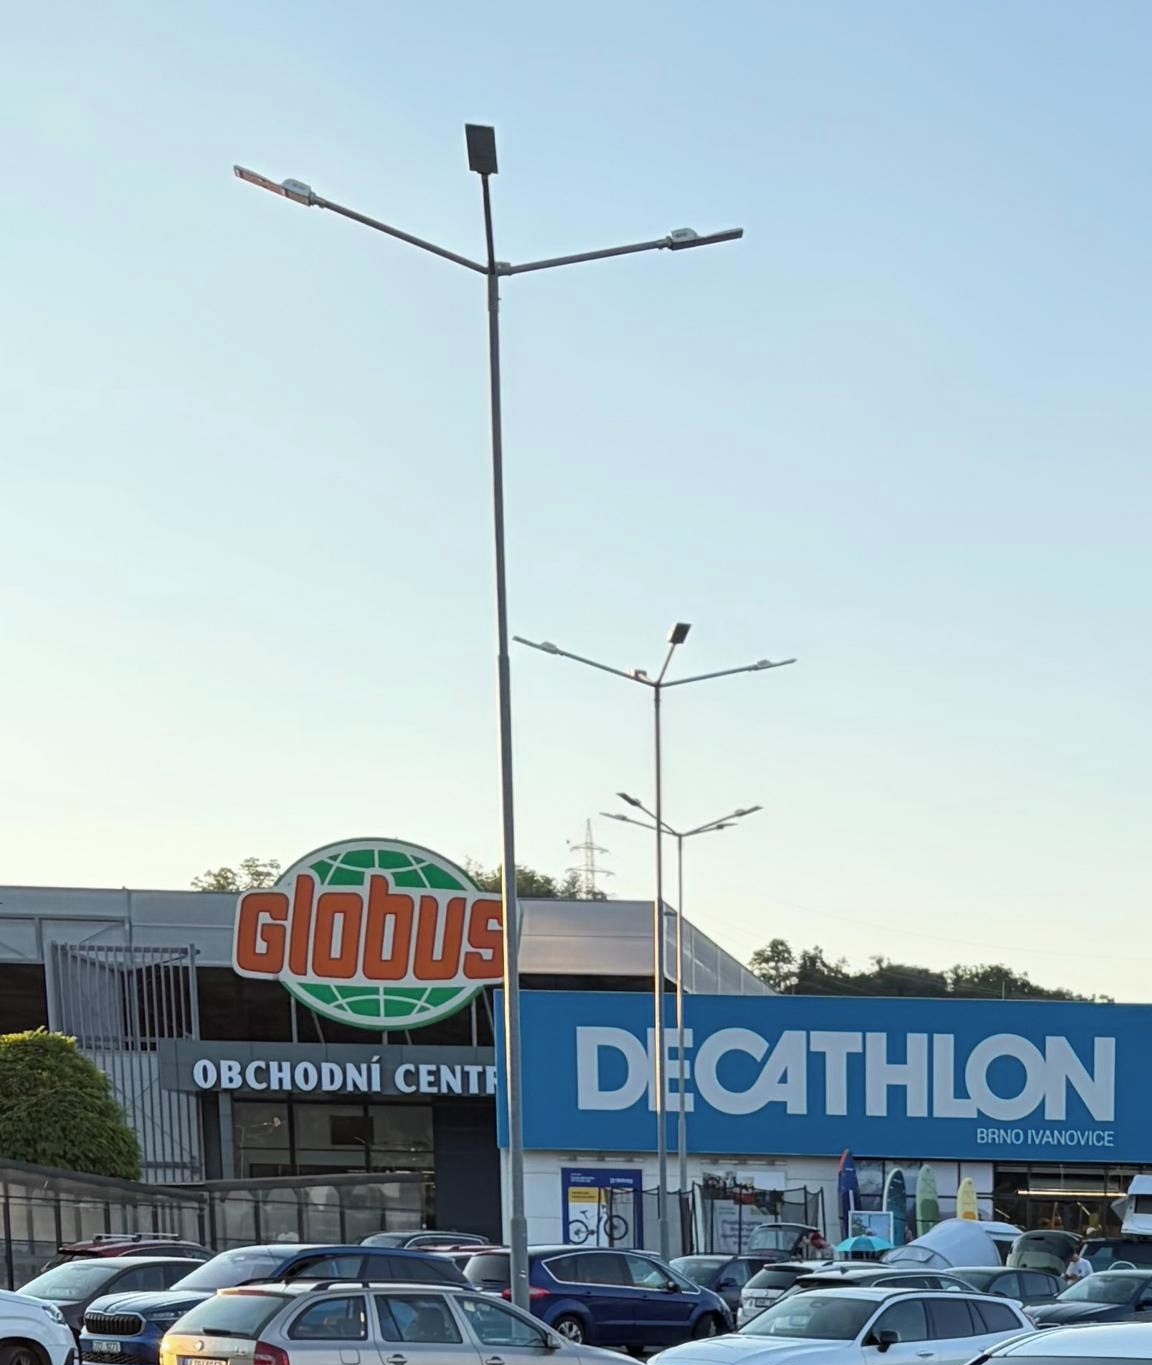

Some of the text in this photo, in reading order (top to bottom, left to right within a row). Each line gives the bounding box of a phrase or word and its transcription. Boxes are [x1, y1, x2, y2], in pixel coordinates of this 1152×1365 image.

[237, 874, 504, 980] Globus
[193, 1056, 381, 1092] OBCHODNÍ
[576, 1026, 1115, 1121] DECATHLON
[976, 1128, 1115, 1147] BRNO IVANOVICE
